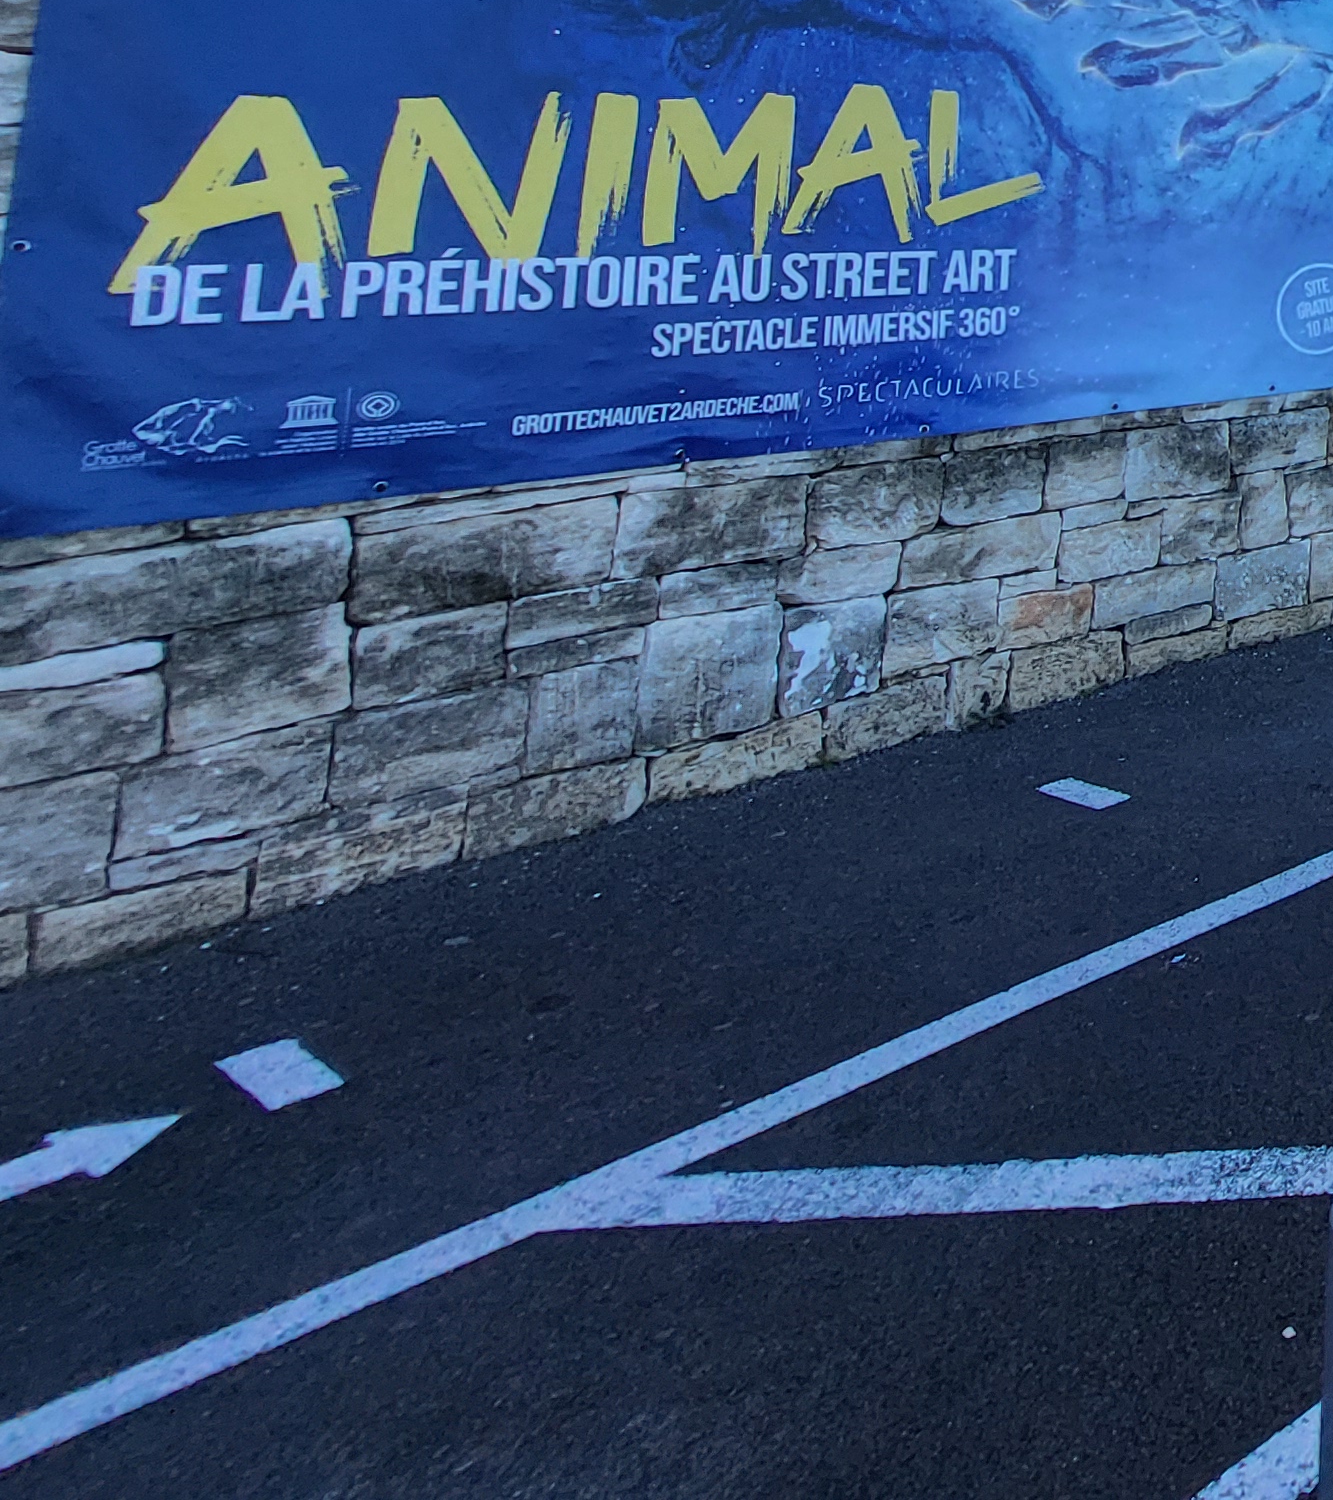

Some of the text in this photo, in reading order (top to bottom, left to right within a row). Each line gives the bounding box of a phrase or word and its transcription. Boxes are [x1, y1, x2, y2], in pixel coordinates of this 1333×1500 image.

[107, 83, 1046, 300] ANIMAL
[130, 247, 1019, 327] DE LA PRÉHISTOIRE AU STREET ART
[1304, 277, 1331, 298] SITE
[650, 304, 1020, 358] SPECTACLE IMMERSIF 360°
[818, 368, 1040, 408] SPECTACULAIRES
[511, 391, 799, 436] GROTTECHAUVET2ARDECHE.COM
